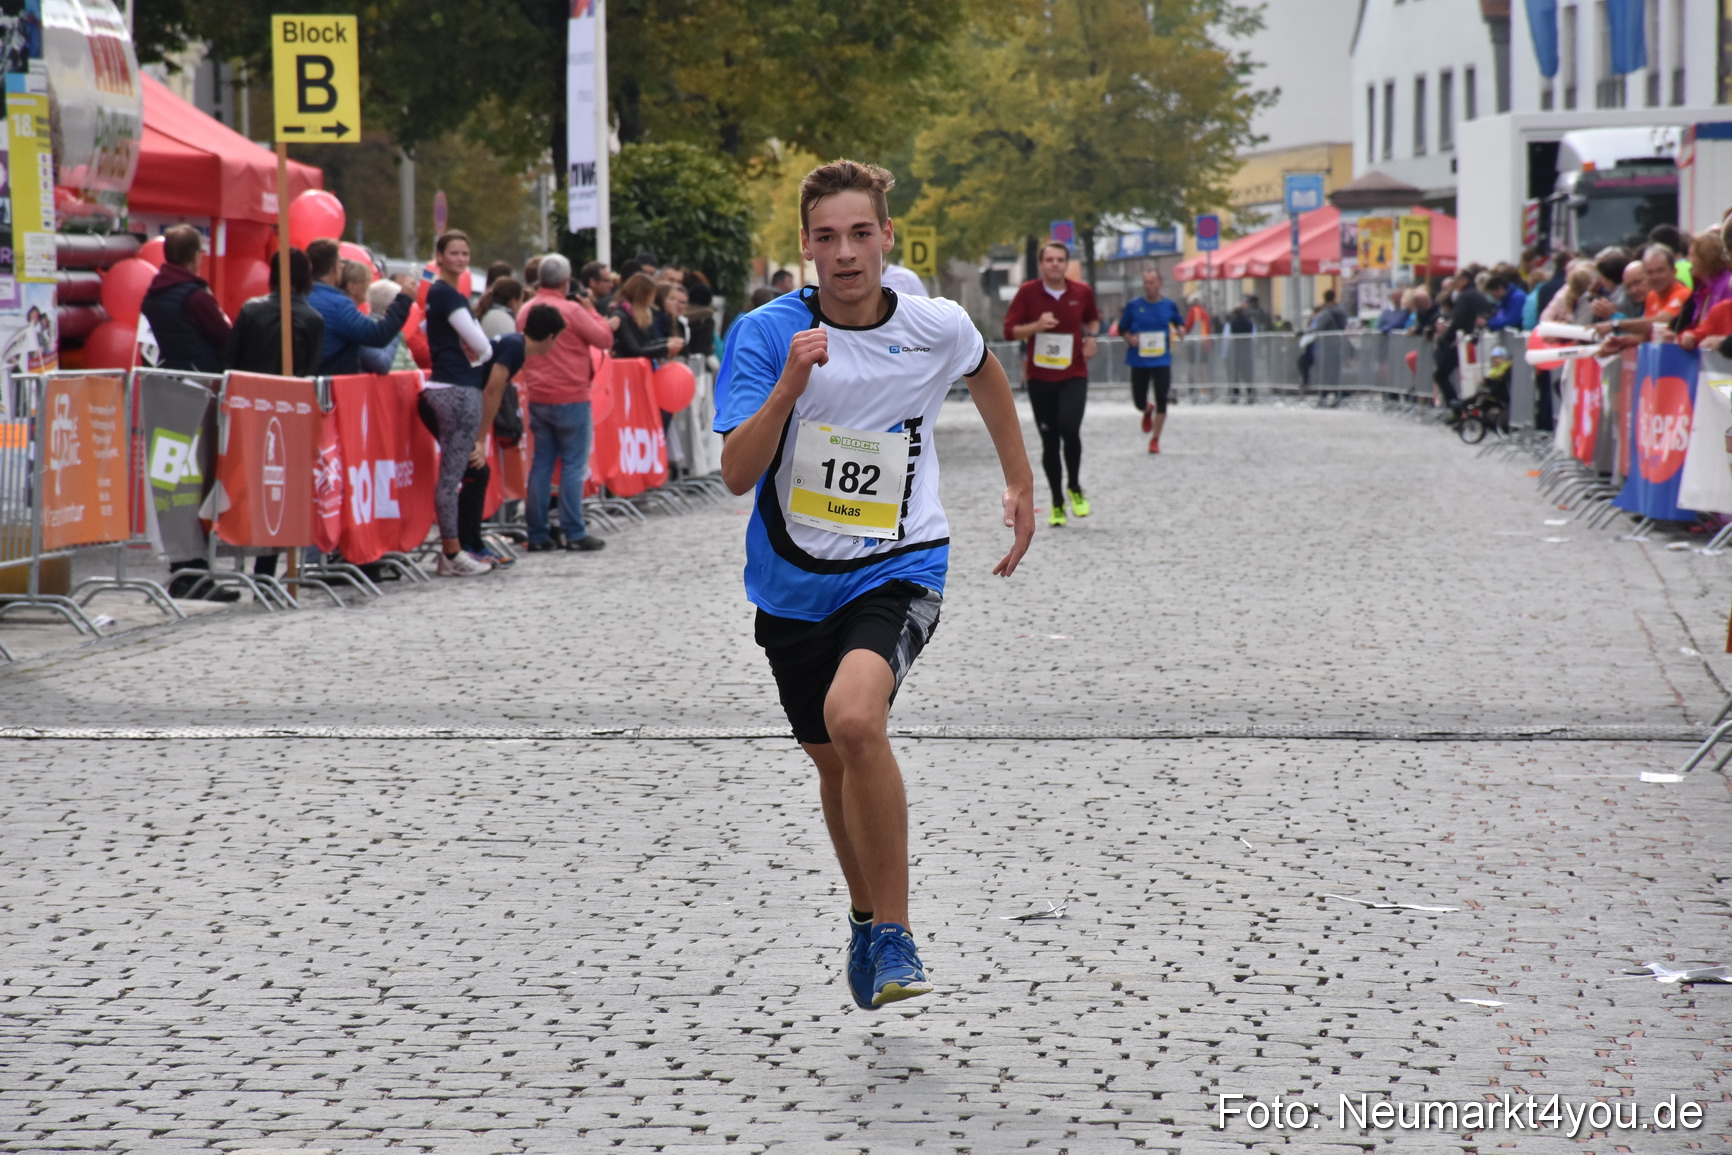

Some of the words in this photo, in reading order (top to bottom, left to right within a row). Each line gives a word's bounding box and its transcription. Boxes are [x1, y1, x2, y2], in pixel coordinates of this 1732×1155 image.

[283, 21, 347, 43] Block
[296, 54, 338, 114] B
[911, 240, 928, 265] D
[1407, 230, 1424, 253] D
[1046, 344, 1060, 356] 38
[841, 437, 880, 451] BOCK
[821, 458, 881, 496] 182
[827, 501, 861, 517] Lukas
